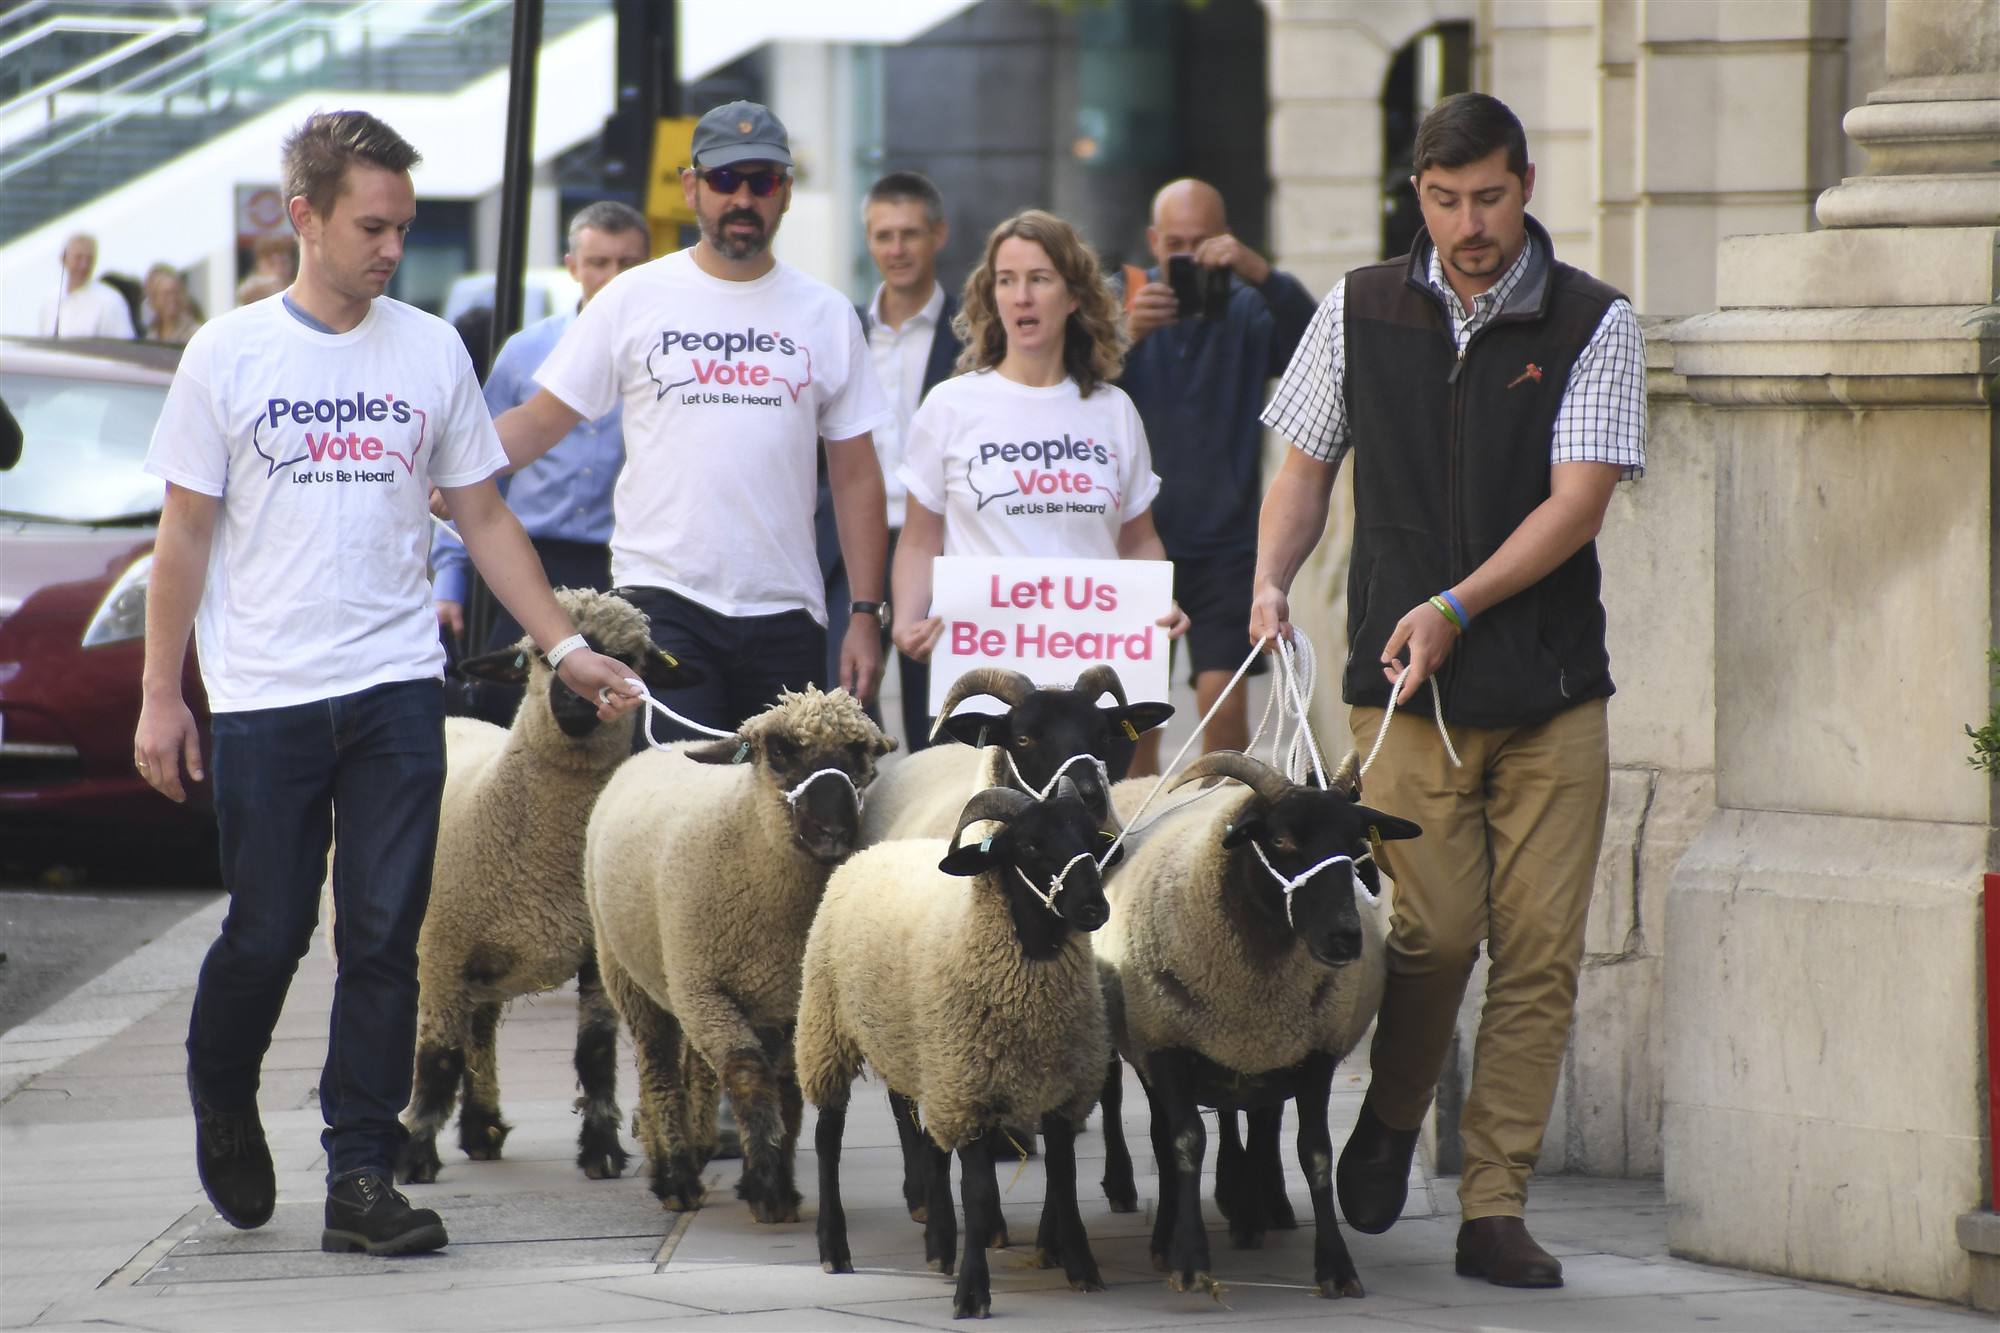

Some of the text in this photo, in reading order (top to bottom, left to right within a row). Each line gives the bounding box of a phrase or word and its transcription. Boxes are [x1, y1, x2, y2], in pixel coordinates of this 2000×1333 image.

[662, 327, 796, 361] People's
[691, 358, 770, 386] Vote
[268, 391, 411, 433] People's
[681, 393, 782, 407] Let Us Be Heard
[305, 432, 384, 462] Vote
[979, 433, 1108, 470] People's
[293, 469, 395, 484] Let Us Be Heard
[1013, 468, 1093, 495] Vote
[1005, 502, 1106, 516] Let Us Be Heard
[990, 574, 1118, 612] Let Us
[951, 620, 1153, 661] Be Heard
